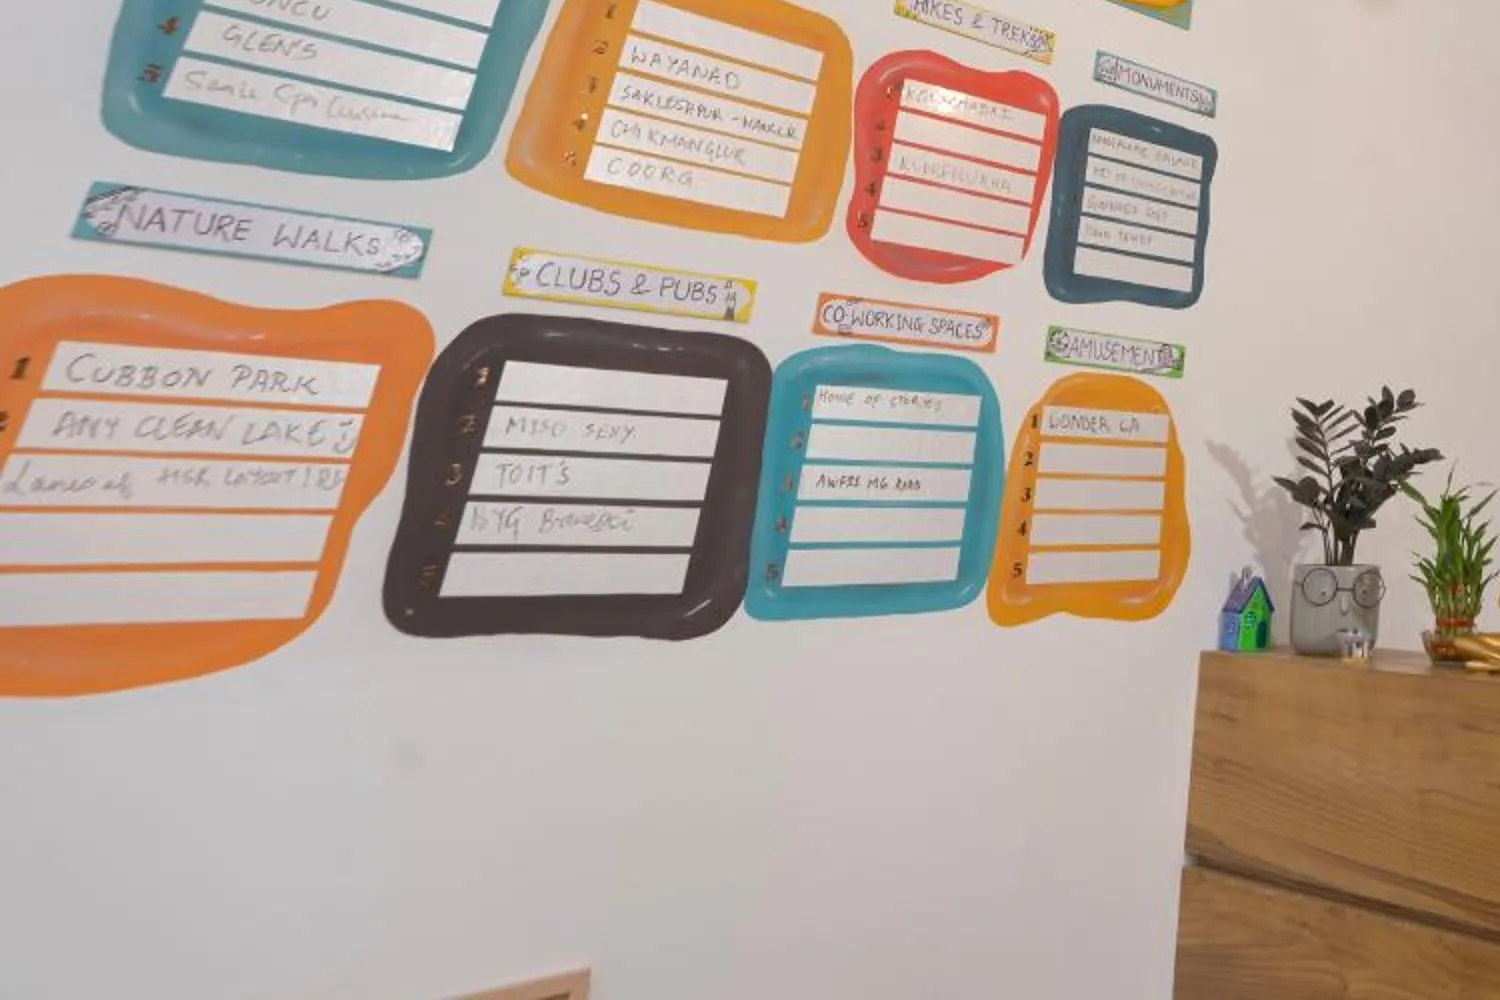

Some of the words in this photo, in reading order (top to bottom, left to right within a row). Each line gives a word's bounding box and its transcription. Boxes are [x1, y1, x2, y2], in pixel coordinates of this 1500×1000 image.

[607, 158, 694, 188] COORG
[114, 203, 253, 242] NATURE
[273, 223, 383, 257] WALKS
[535, 260, 622, 297] CLUBS
[630, 273, 653, 296] &
[659, 276, 719, 305] PUBS
[927, 316, 983, 341] SPACES
[8, 357, 31, 380] 1
[66, 353, 210, 386] CUBBON
[231, 365, 320, 396] PARK
